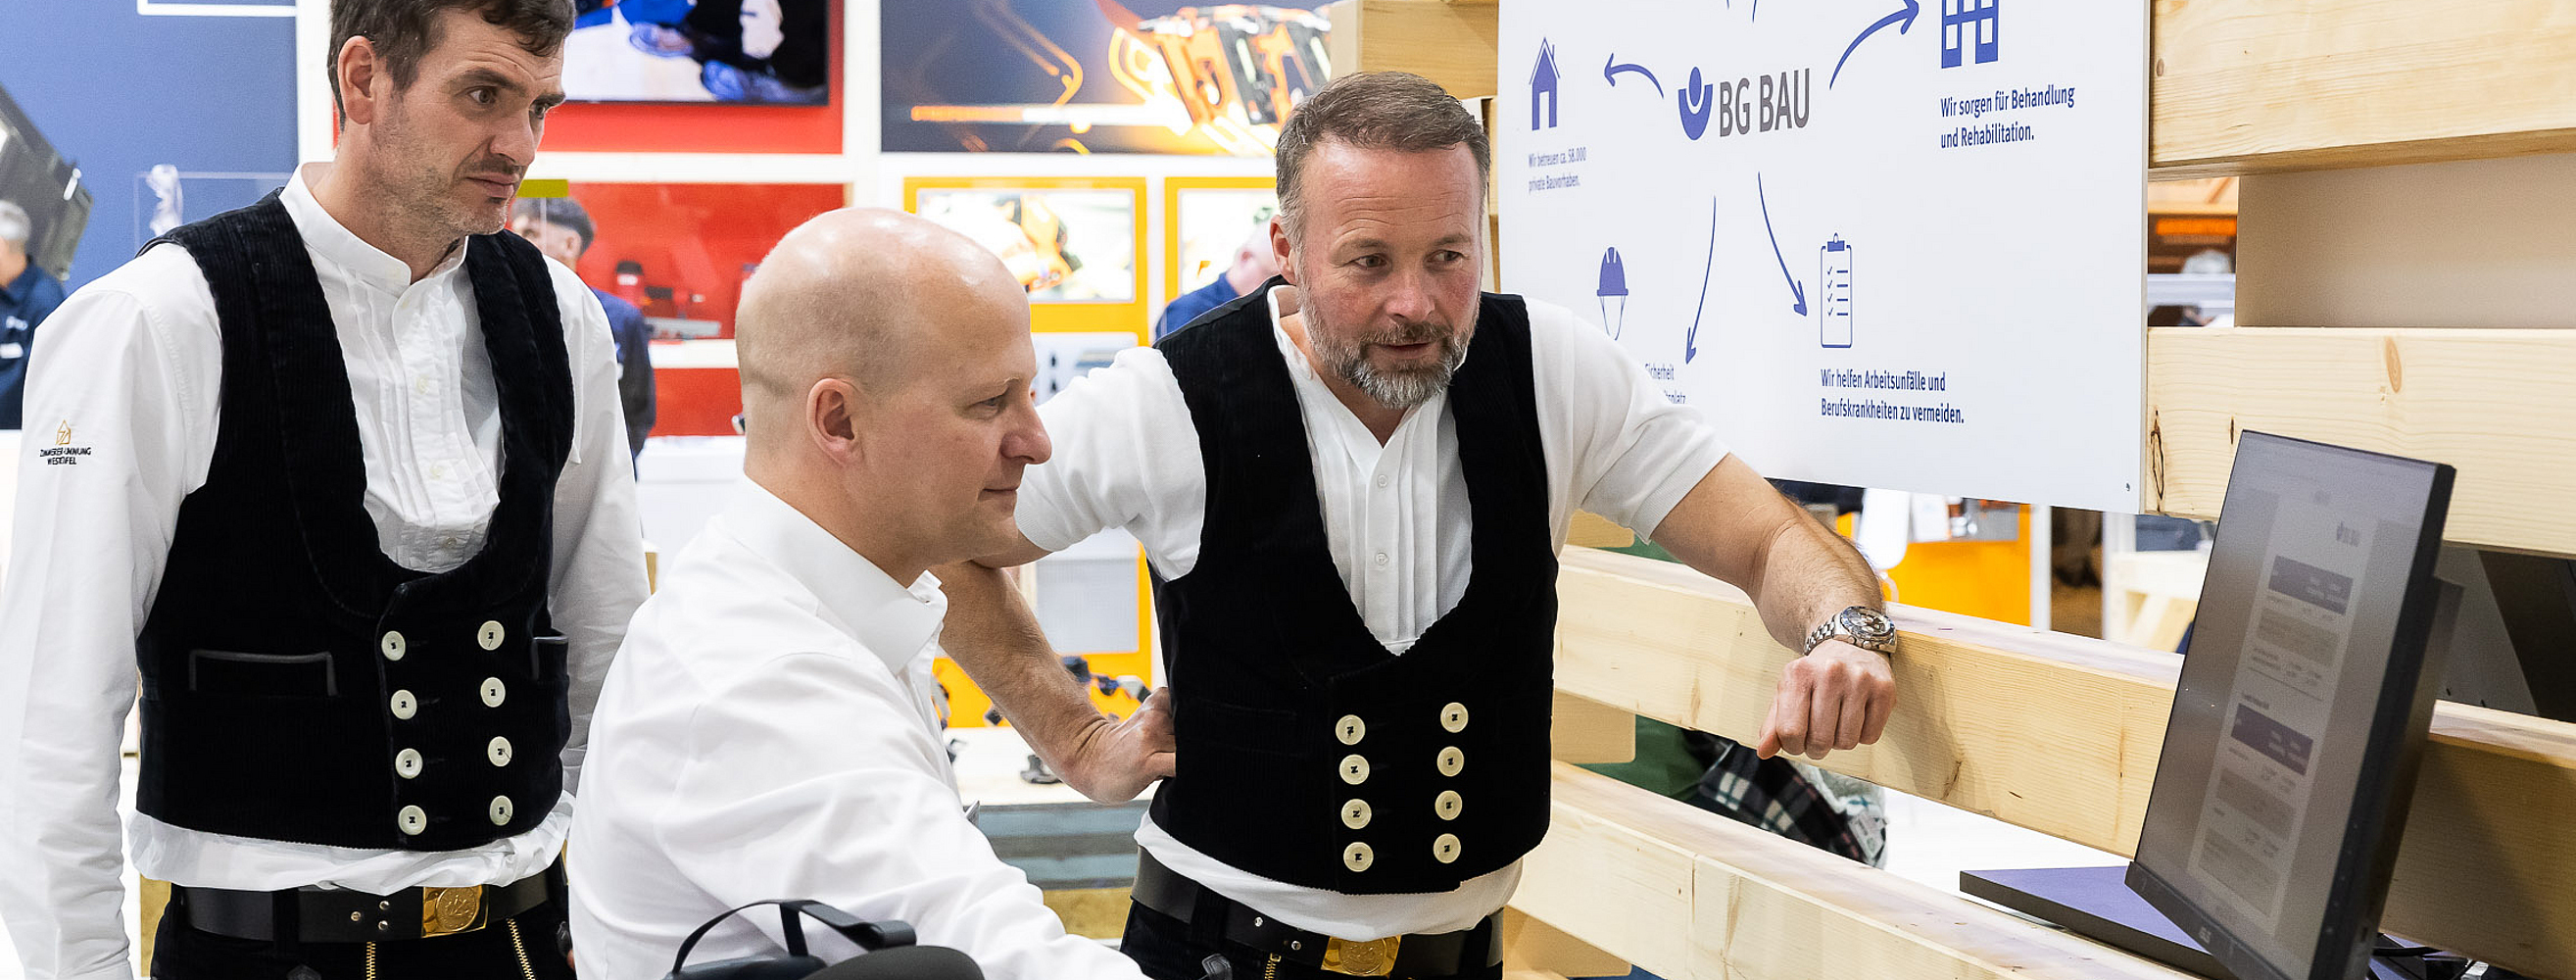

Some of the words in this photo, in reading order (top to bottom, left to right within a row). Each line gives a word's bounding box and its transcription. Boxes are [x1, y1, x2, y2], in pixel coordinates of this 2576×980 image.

[1720, 77, 1751, 137] BG
[1760, 68, 1810, 132] BAU
[1940, 96, 1958, 118] Wir
[1959, 97, 1992, 119] sorgen
[1995, 90, 2010, 111] für
[2012, 83, 2075, 109] Behandlung
[1941, 126, 1959, 148] und
[1961, 121, 2035, 147] Rehabilitation.
[1537, 153, 1559, 167] betreuen
[1529, 177, 1545, 195] private
[1821, 368, 1835, 387] Wir
[1836, 368, 1863, 388] helfen
[1864, 369, 1926, 391] Arbeitsunfälle
[1927, 370, 1946, 392] und
[1822, 397, 1898, 419] Berufskrankheiten
[1900, 406, 1912, 421] zu
[1912, 402, 1965, 423] vermeiden.
